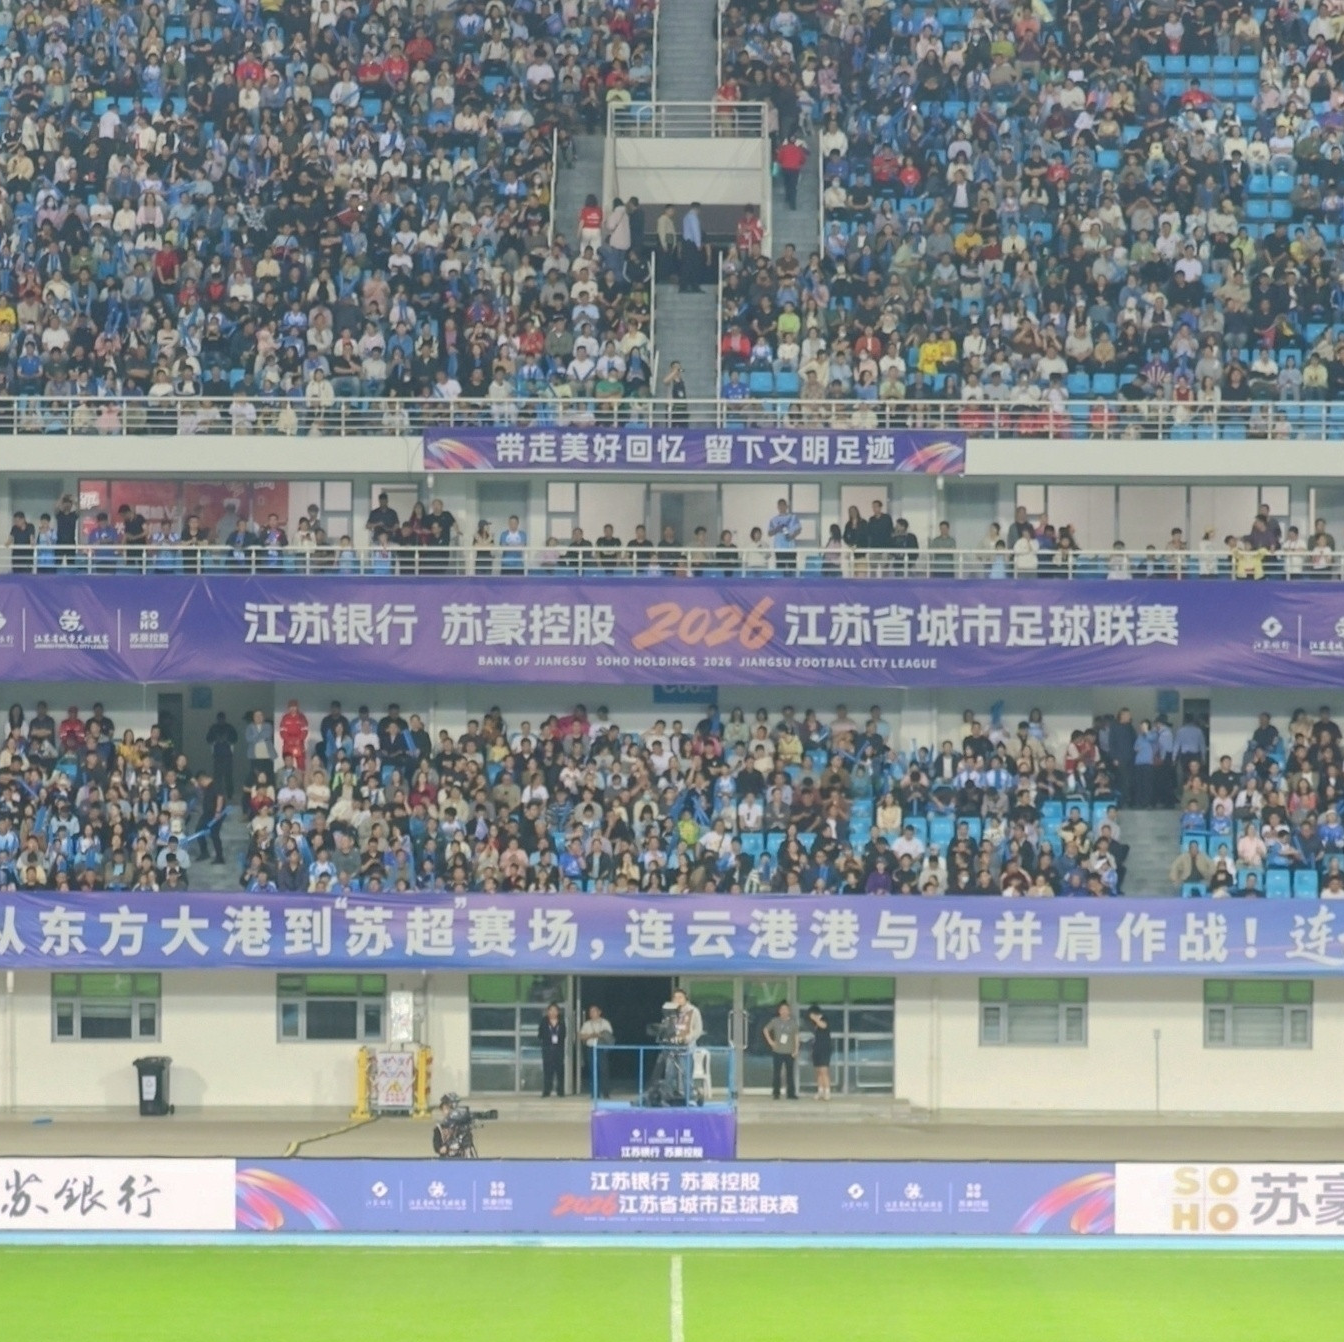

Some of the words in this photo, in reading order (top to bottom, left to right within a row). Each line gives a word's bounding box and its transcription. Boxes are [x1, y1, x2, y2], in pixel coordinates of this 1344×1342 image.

[495, 432, 686, 465] 带走美好回忆
[704, 433, 896, 466] 留下文明足迹
[244, 602, 418, 646] 江苏银行
[440, 602, 615, 647] 苏豪控股
[630, 596, 776, 650] 2026
[784, 603, 1179, 648] 江苏省城市足球联赛
[478, 656, 510, 667] BANK
[513, 656, 529, 667] OF
[533, 656, 587, 667] JIANGSU
[596, 656, 629, 667] SOHO
[633, 656, 696, 667] HOLDINGS
[703, 657, 732, 668] 2026
[739, 657, 791, 668] JIANGSU
[795, 657, 856, 668] FOOTBALL
[860, 658, 887, 669] CITY
[890, 658, 938, 669] LEAGUE
[590, 1171, 670, 1192] 江苏银行
[680, 1171, 761, 1192] 苏豪控股
[619, 1194, 799, 1215] 江苏省城市足球联赛
